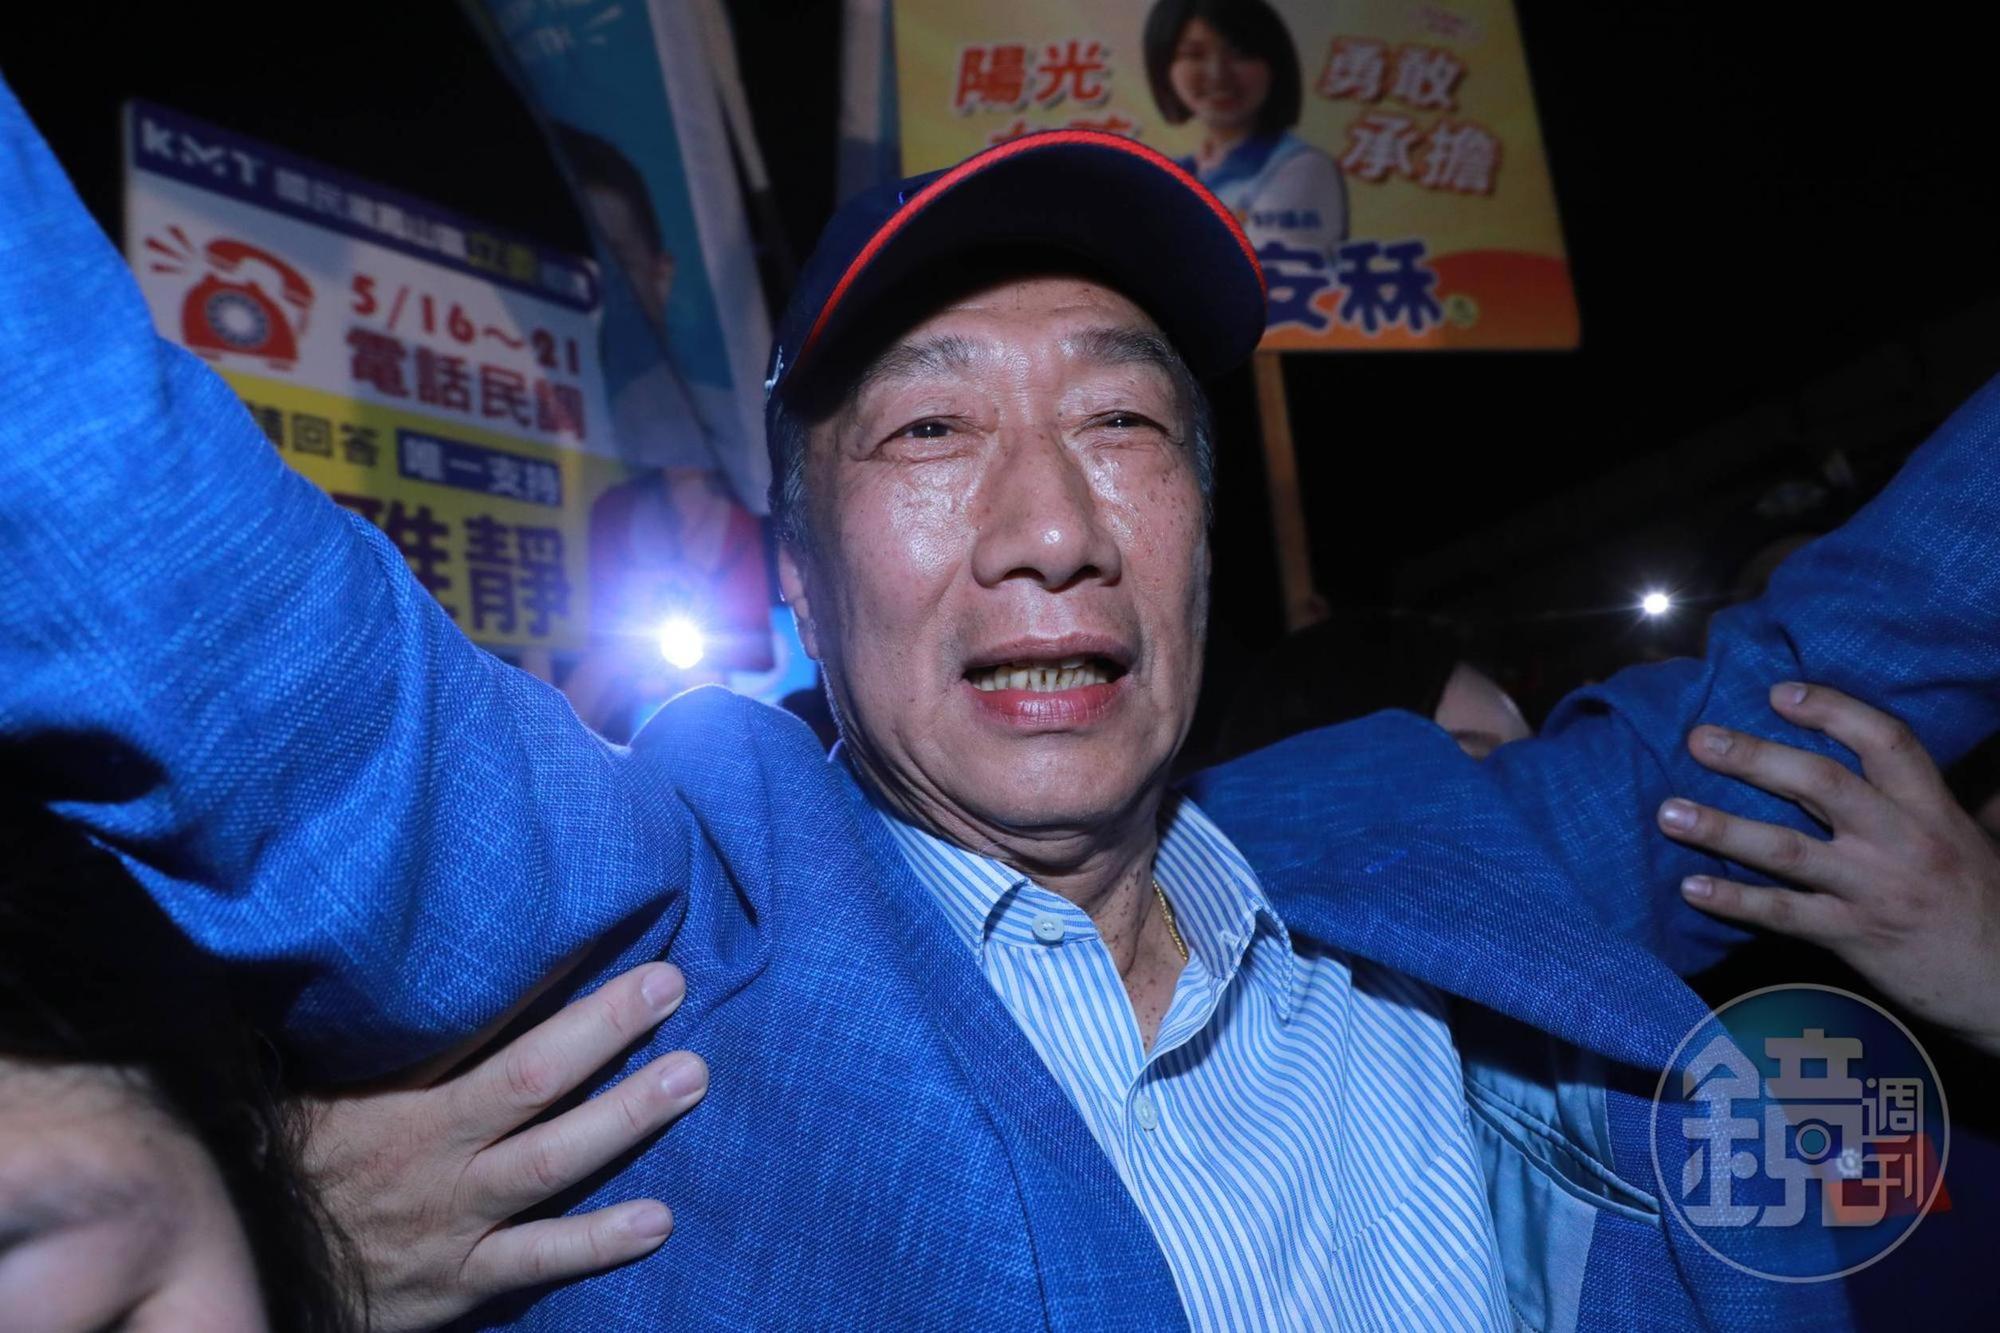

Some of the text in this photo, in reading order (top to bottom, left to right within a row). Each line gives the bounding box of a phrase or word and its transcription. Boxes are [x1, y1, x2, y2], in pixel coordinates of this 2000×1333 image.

[956, 40, 1109, 108] 陽光
[1318, 36, 1466, 111] 勇敢
[142, 117, 265, 184] KMT
[1341, 113, 1501, 194] 承擔
[346, 327, 587, 440] 電話民調
